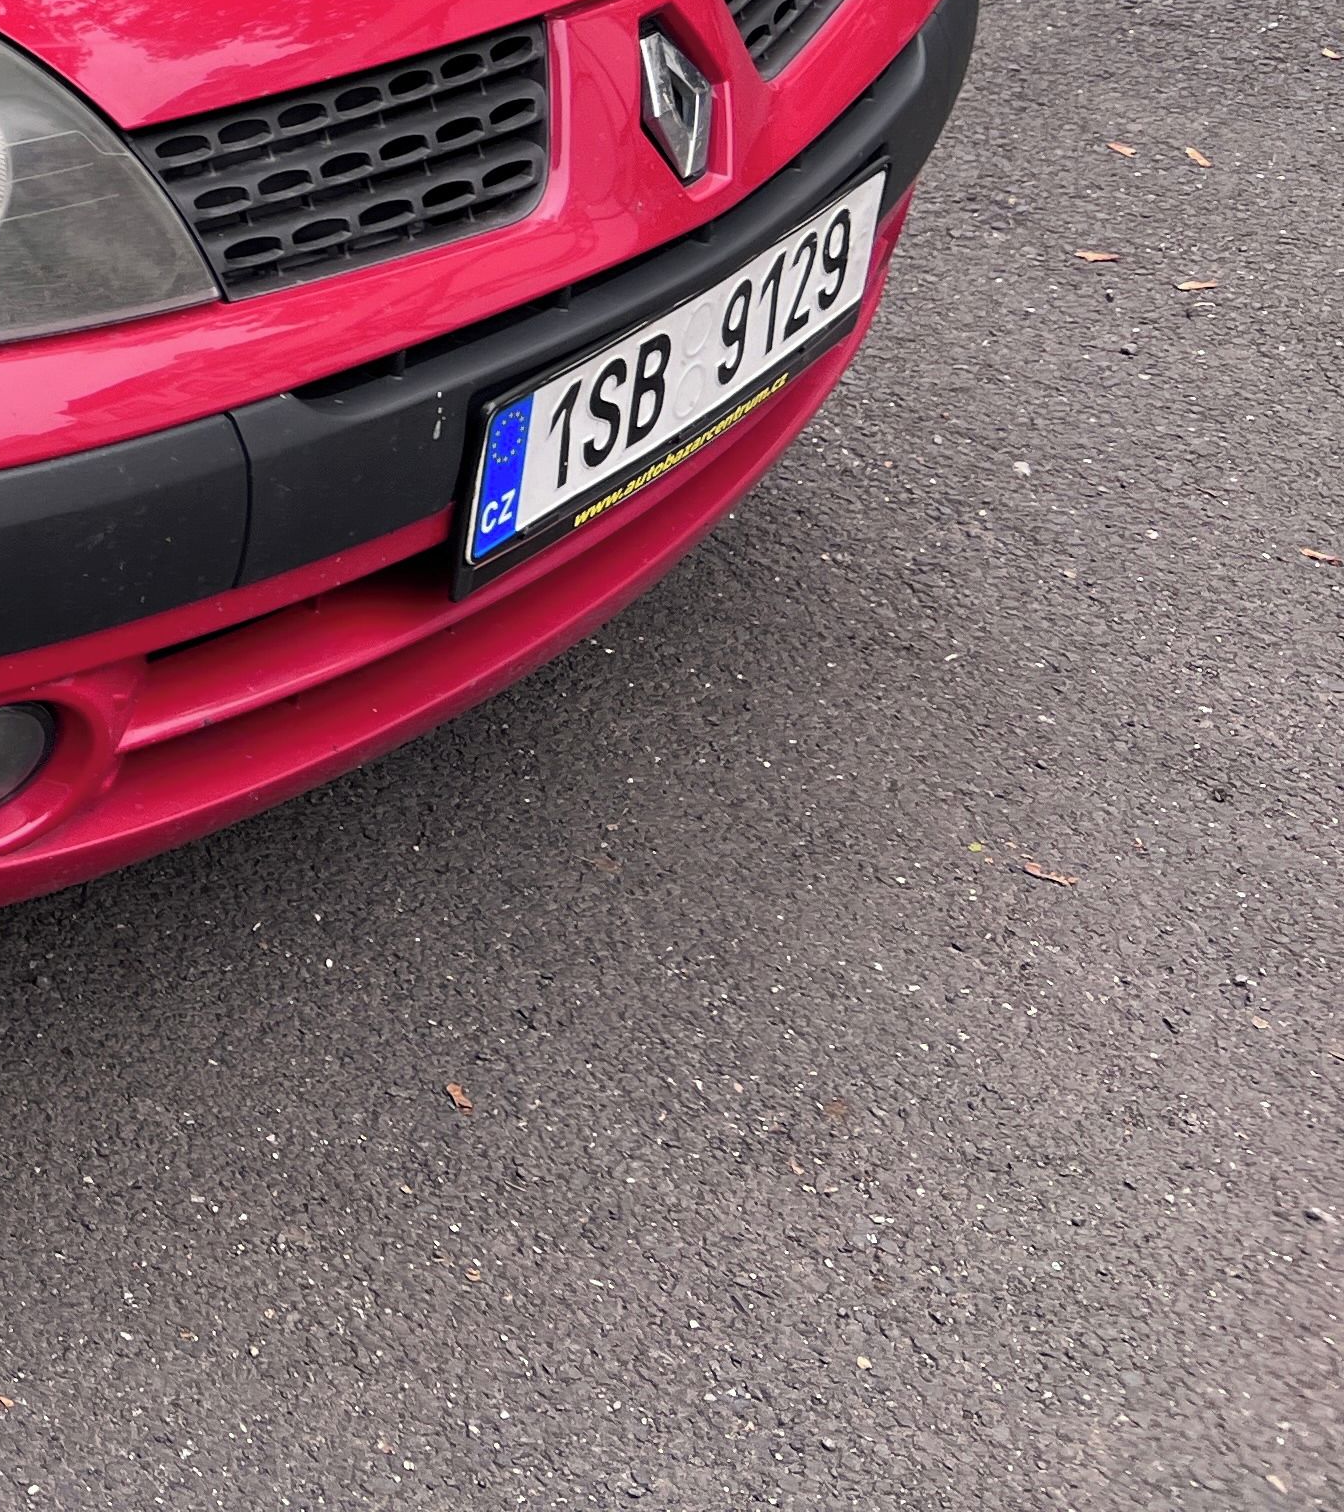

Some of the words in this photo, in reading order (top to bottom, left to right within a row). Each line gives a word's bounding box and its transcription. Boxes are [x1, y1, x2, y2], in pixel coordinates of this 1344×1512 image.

[480, 488, 516, 535] CZ
[549, 332, 672, 490] 1SB
[716, 207, 852, 385] 9129
[573, 372, 790, 528] www.autobazarcentrum.cz
